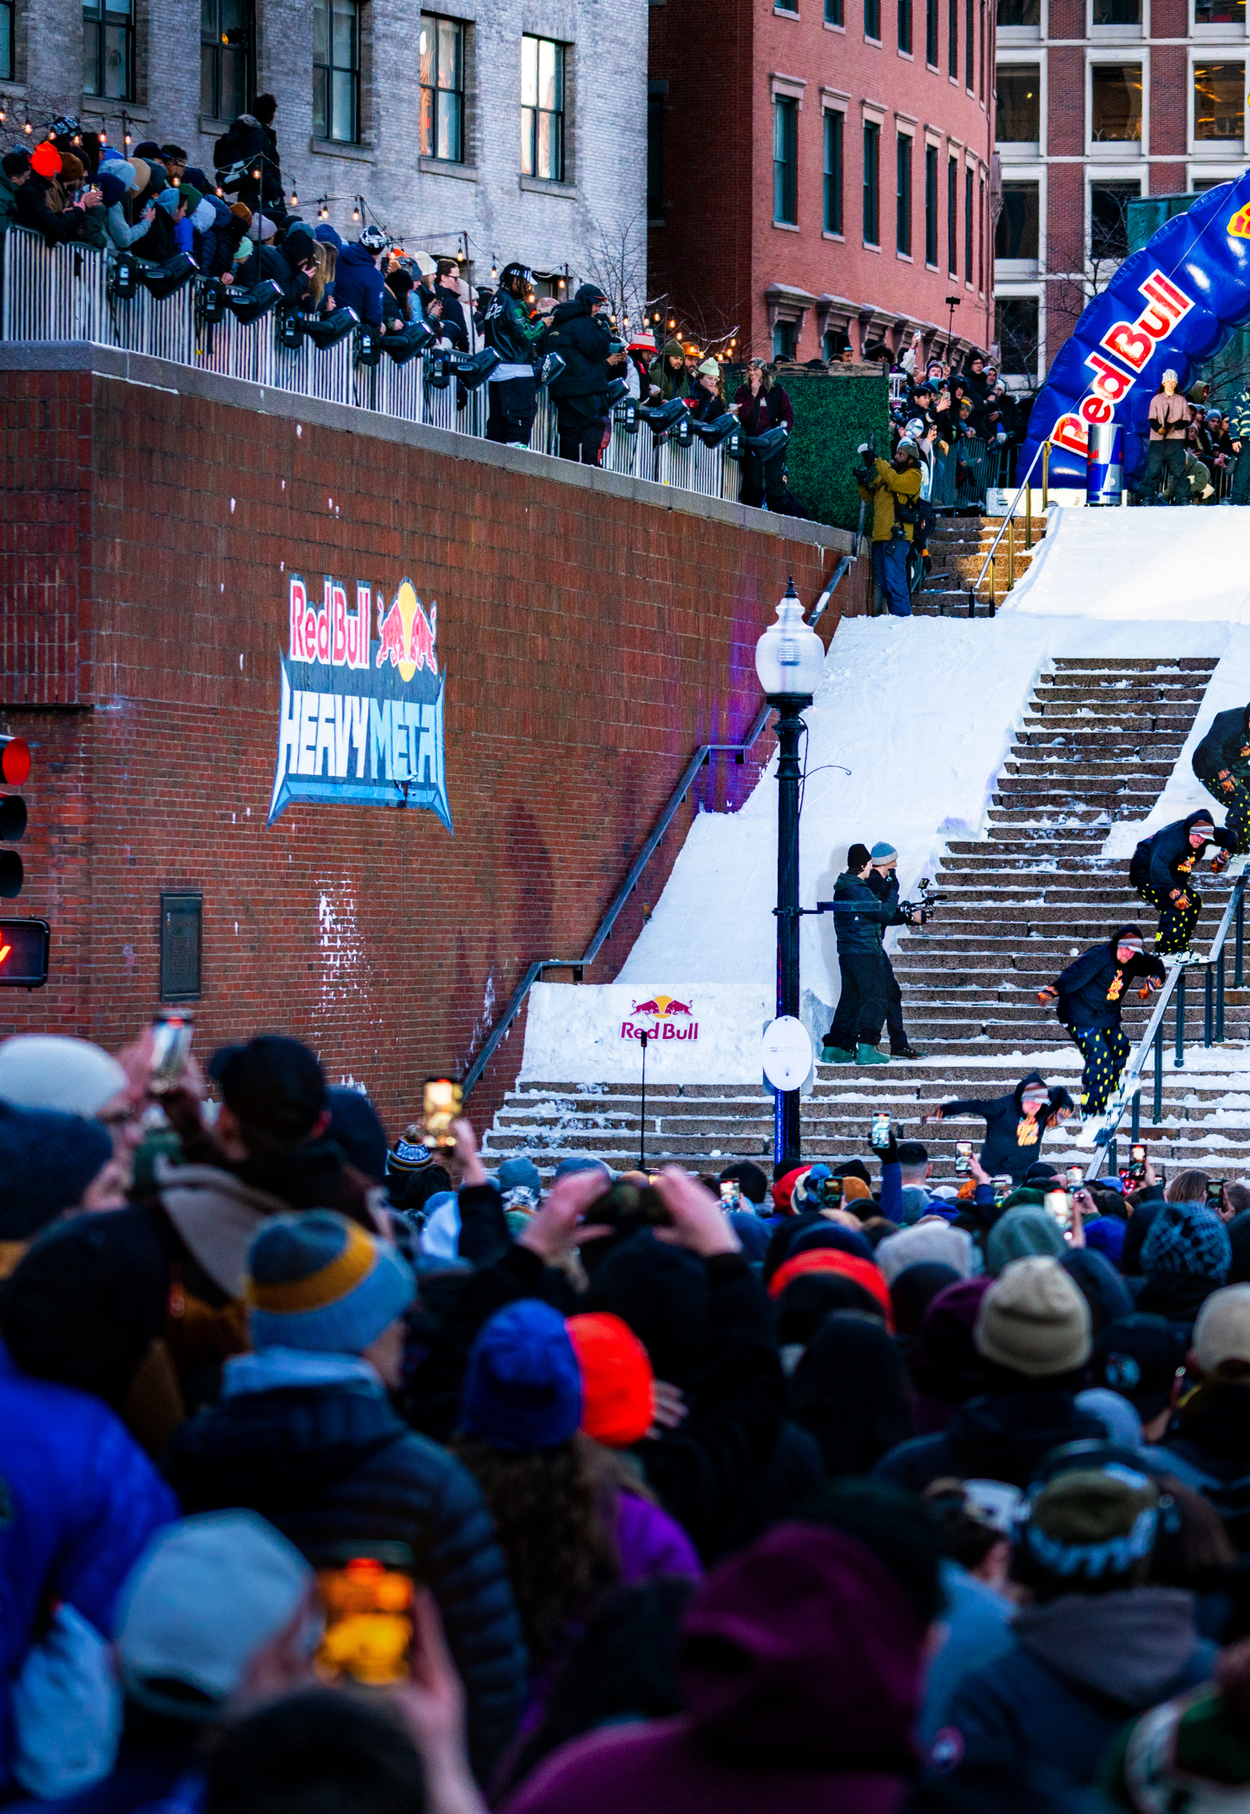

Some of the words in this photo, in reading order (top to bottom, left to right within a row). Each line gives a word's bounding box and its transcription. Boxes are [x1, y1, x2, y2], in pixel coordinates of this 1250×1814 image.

[1051, 353, 1133, 456] Red
[1102, 272, 1192, 370] Bull
[290, 581, 331, 664] Red
[332, 585, 370, 667] Bull
[274, 677, 369, 798] HEAVY
[621, 1021, 659, 1040] Red
[662, 1022, 699, 1040] Bull
